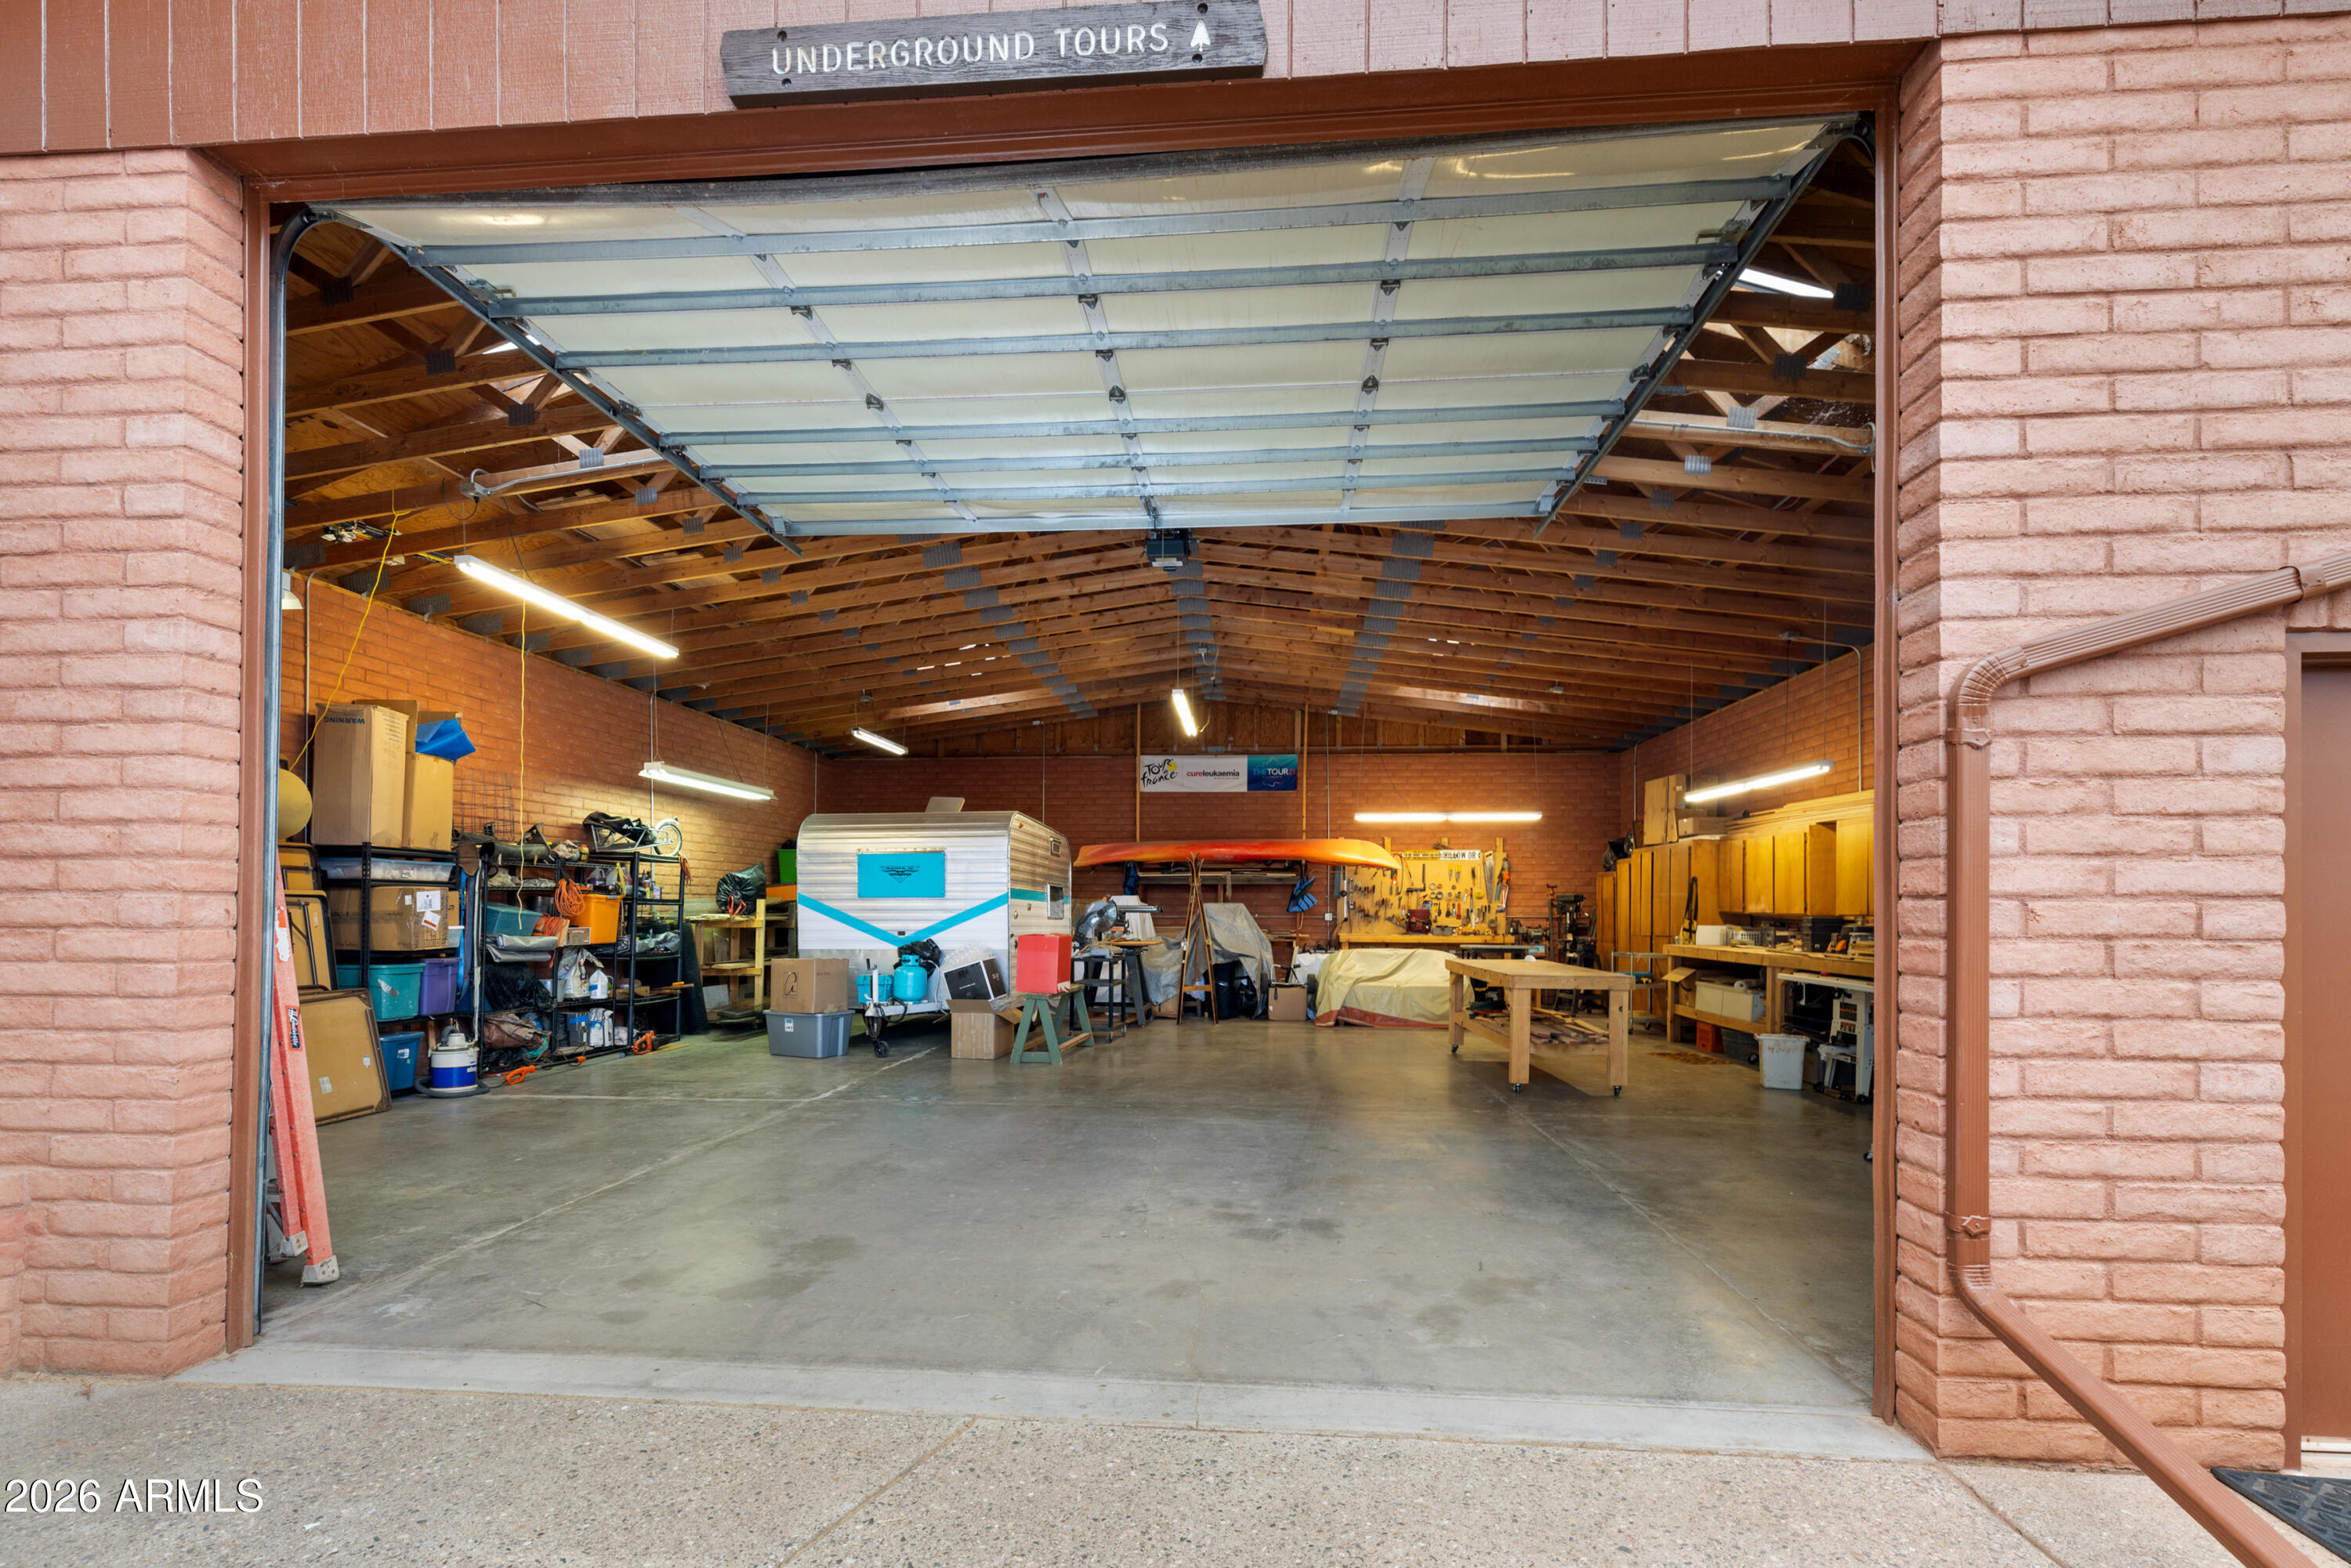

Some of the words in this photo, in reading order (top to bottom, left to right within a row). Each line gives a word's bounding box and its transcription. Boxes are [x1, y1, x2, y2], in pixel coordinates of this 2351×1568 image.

[771, 33, 1035, 75] UNDERGROUND
[1054, 21, 1169, 58] TOURS
[1186, 769, 1240, 777] cureleukaemia
